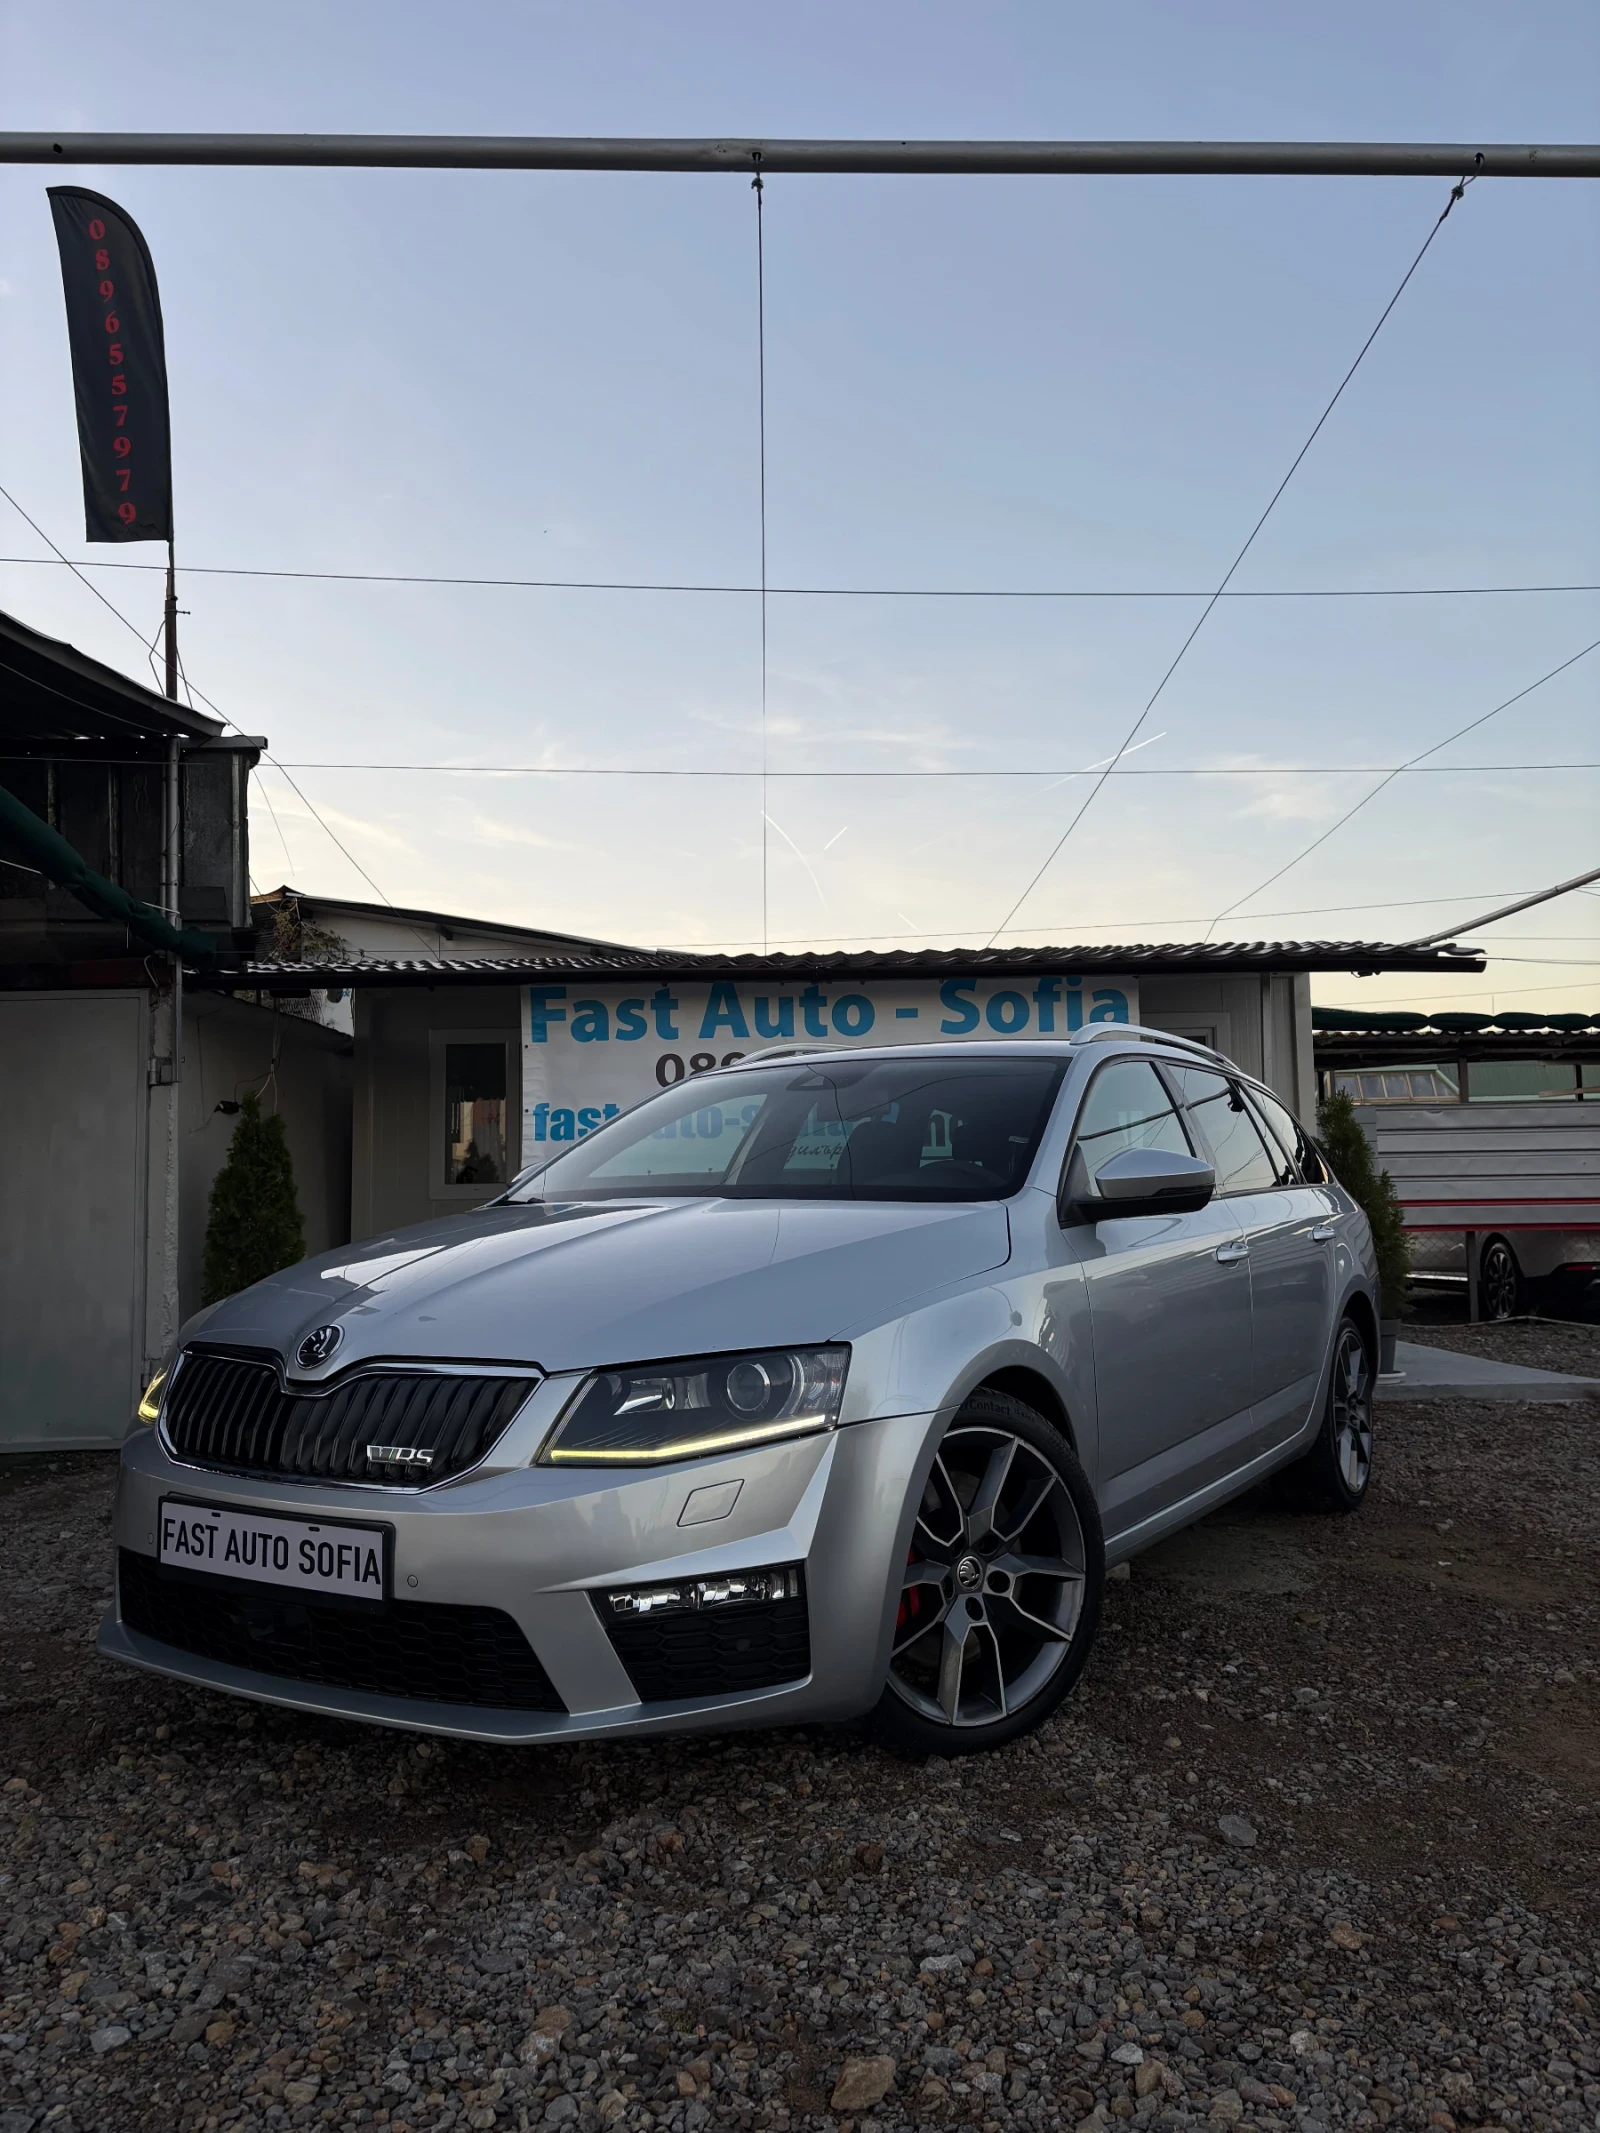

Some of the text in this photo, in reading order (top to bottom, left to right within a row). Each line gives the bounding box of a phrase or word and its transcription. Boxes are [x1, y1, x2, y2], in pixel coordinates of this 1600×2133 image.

[88, 219, 137, 526] 0896557979
[531, 976, 1128, 1043] Fast Auto - Sofia
[163, 1517, 381, 1585] FAST AUTO SOFIA
